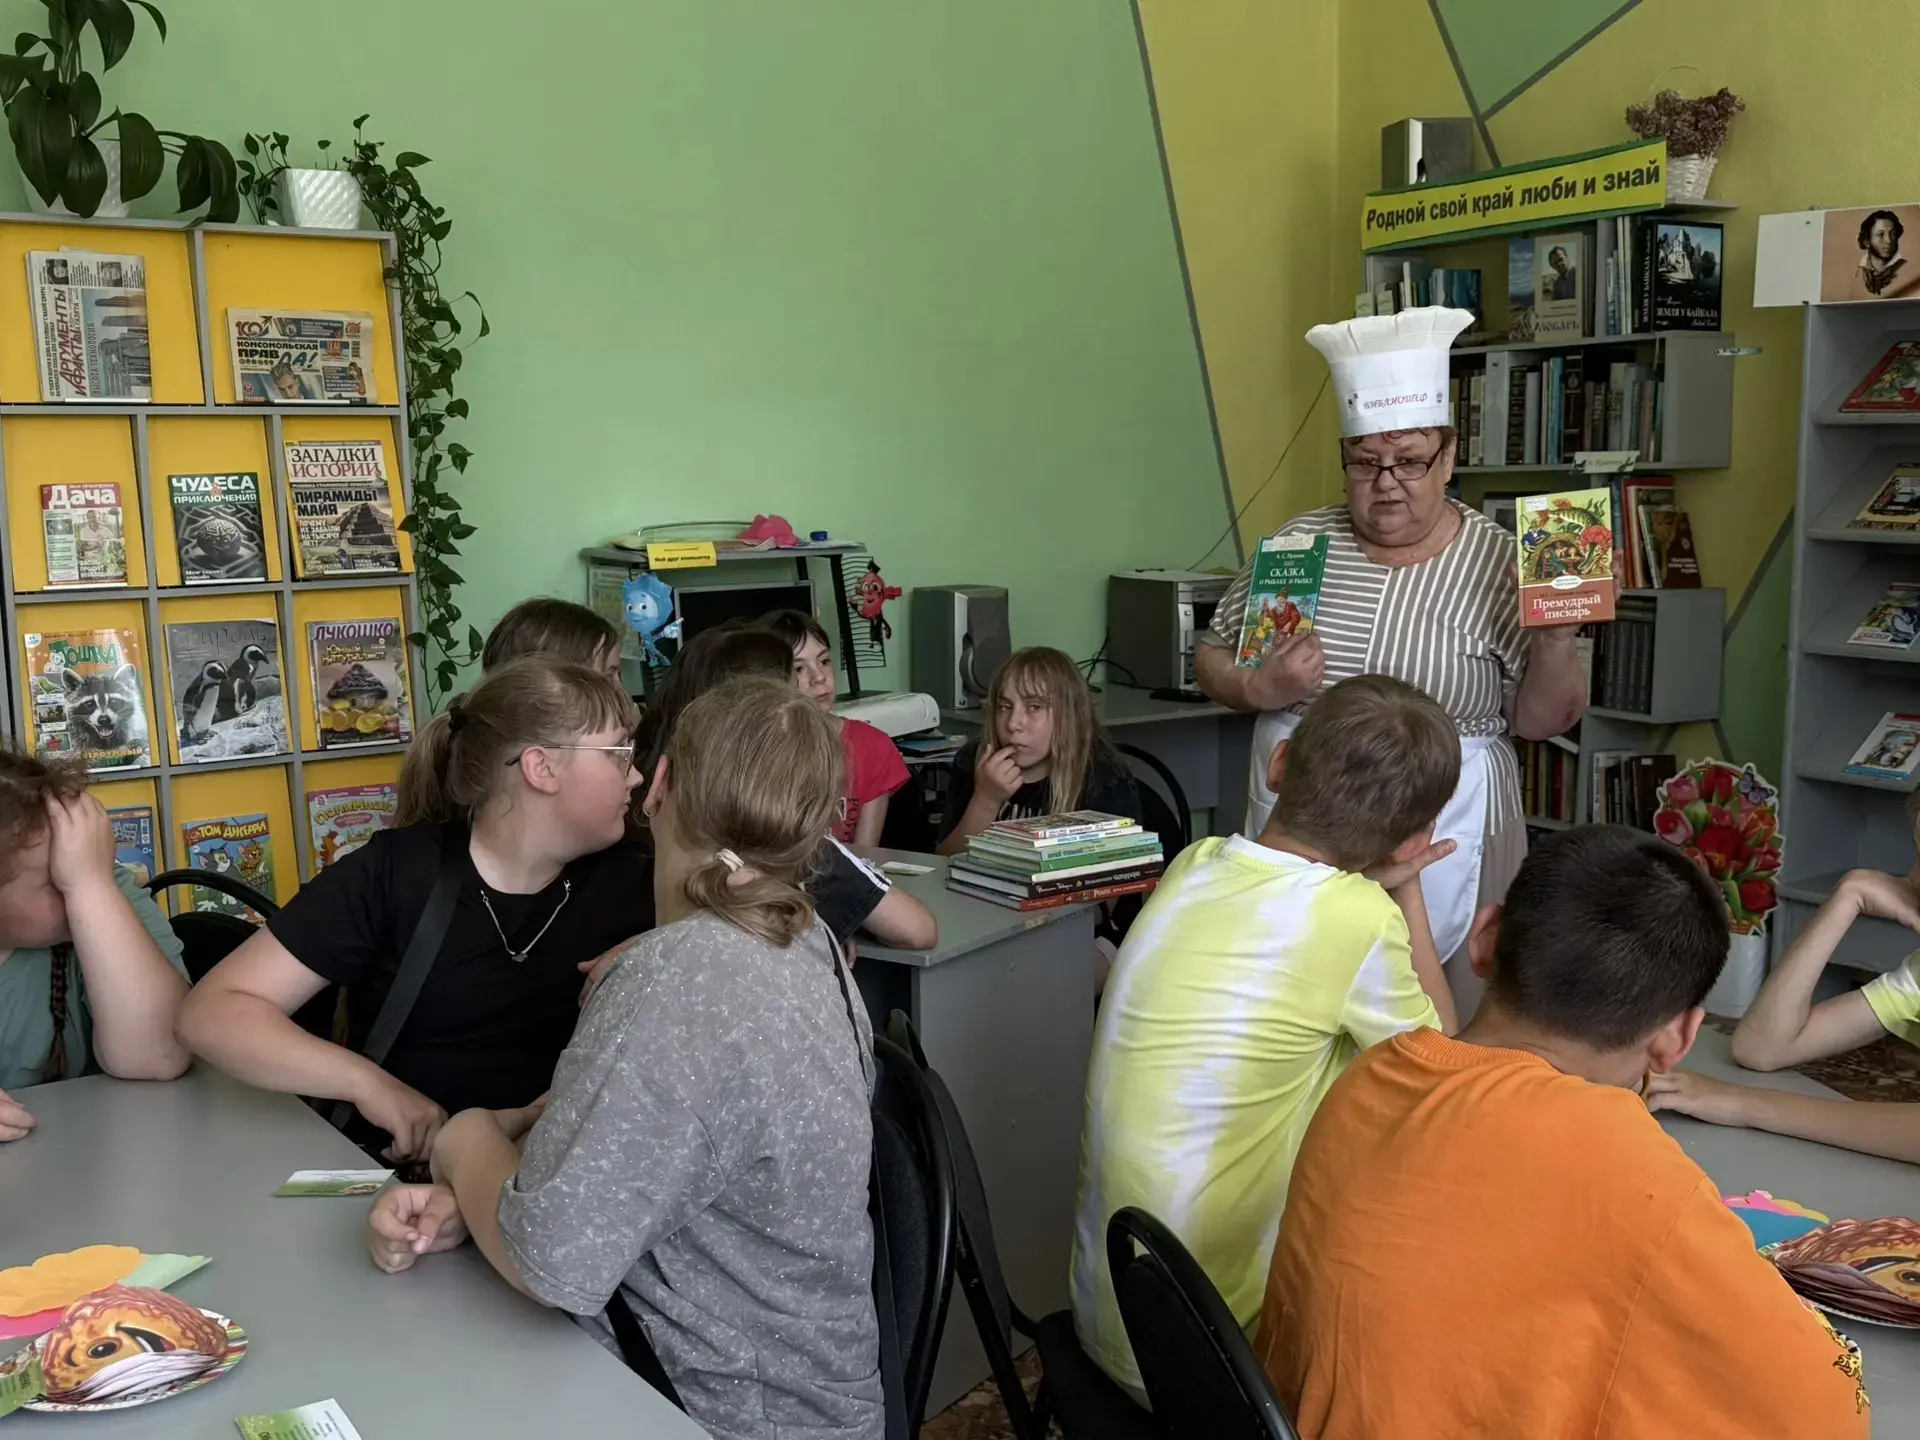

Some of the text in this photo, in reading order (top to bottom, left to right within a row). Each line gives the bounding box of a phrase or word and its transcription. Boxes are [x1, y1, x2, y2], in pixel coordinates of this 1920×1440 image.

[1366, 159, 1660, 231] Родной свой край люби и знай
[53, 287, 73, 383] АРГУМЕНТЫ
[237, 340, 318, 351] КОМСОМОЛЬСКАЯ
[291, 448, 377, 464] ЗАГАДКИ
[292, 462, 380, 477] ИСТОРИИ
[171, 475, 256, 492] ЧУДЕСА
[48, 485, 116, 511] Дача
[173, 493, 257, 504] ПРИКЛЮЧЕНИЯ
[295, 489, 378, 503] ПИРАМИДЫ
[297, 501, 339, 516] МАЙЯ
[1270, 567, 1305, 577] СКАЗКА
[1533, 593, 1602, 612] Премудрый
[1544, 607, 1591, 620] пискарь
[314, 622, 394, 640] ЛУКОШКО
[198, 821, 267, 838] ТОМ ДЖЕРРИ
